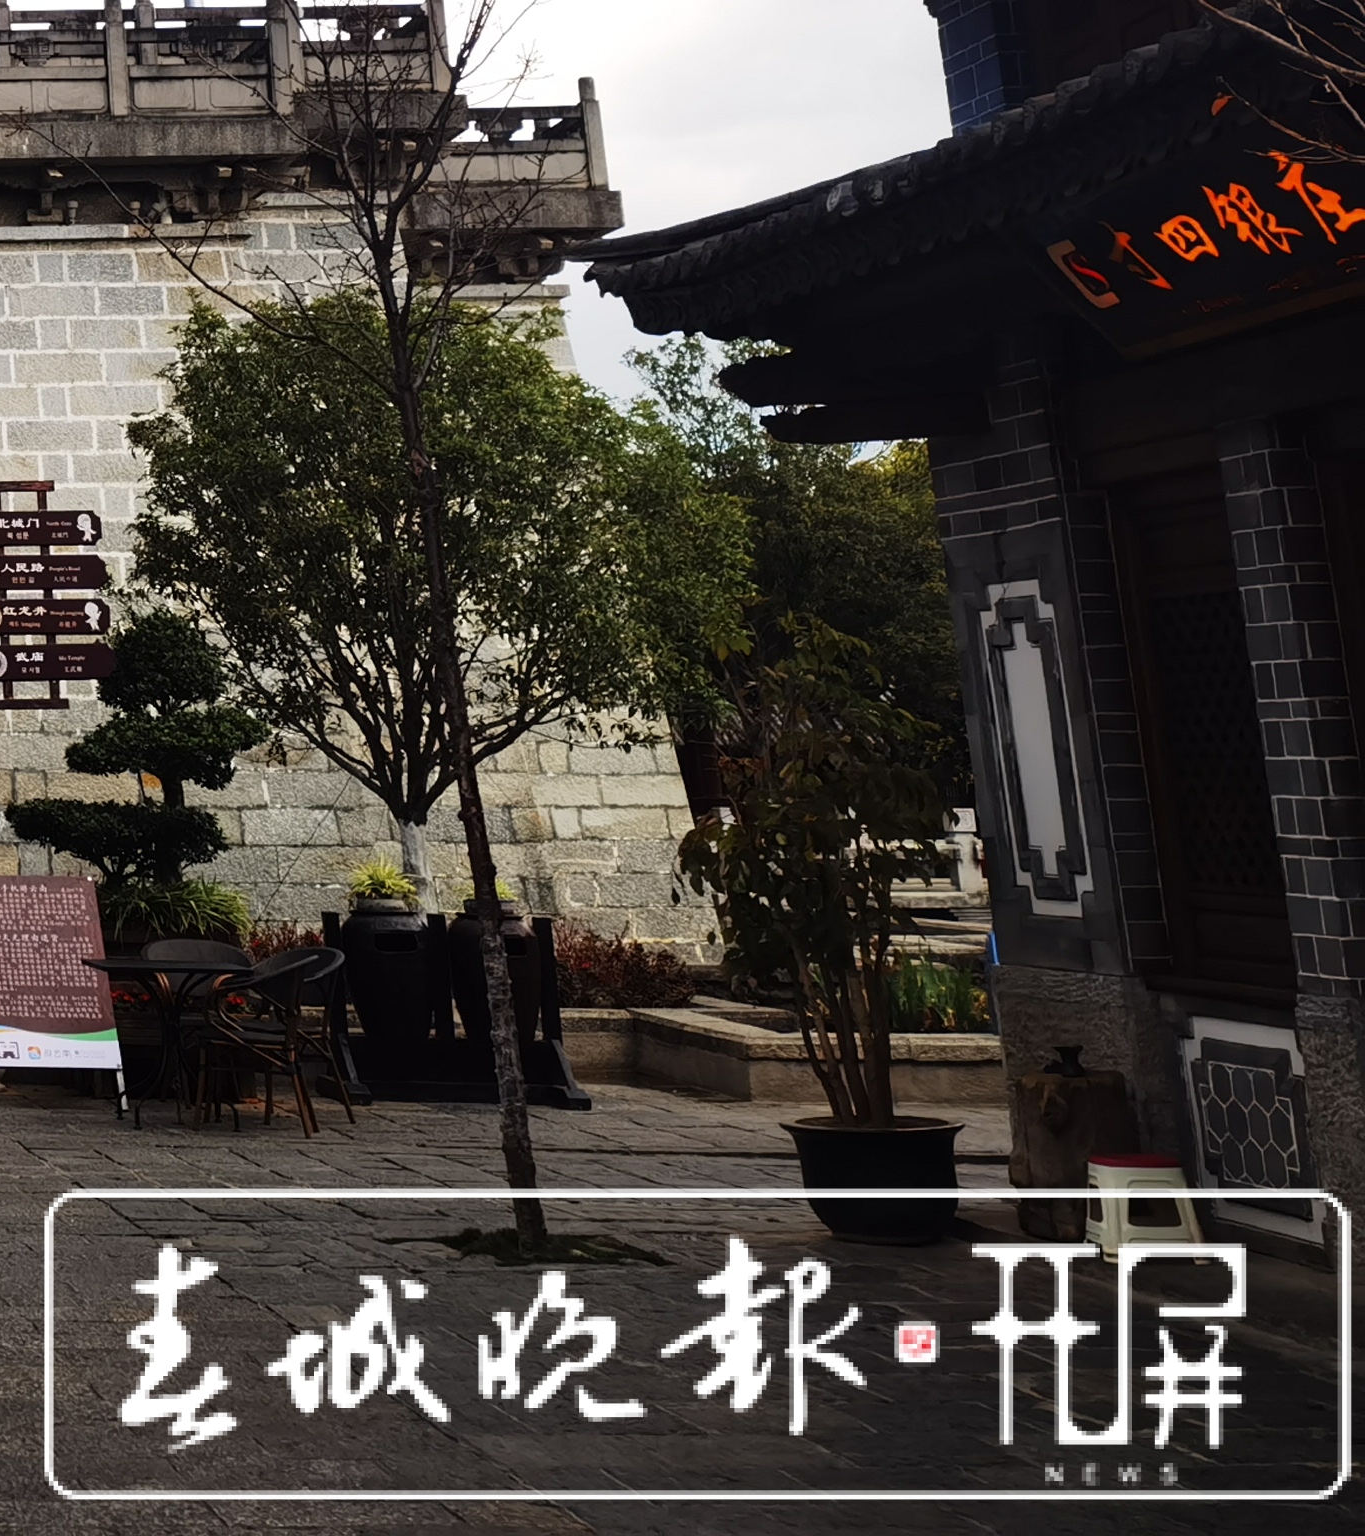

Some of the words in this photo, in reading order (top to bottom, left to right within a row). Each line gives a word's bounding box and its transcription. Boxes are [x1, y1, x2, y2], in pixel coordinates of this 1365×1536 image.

[0, 562, 45, 573] 人民路
[2, 605, 47, 617] 红龙井
[14, 651, 45, 663] 武庙
